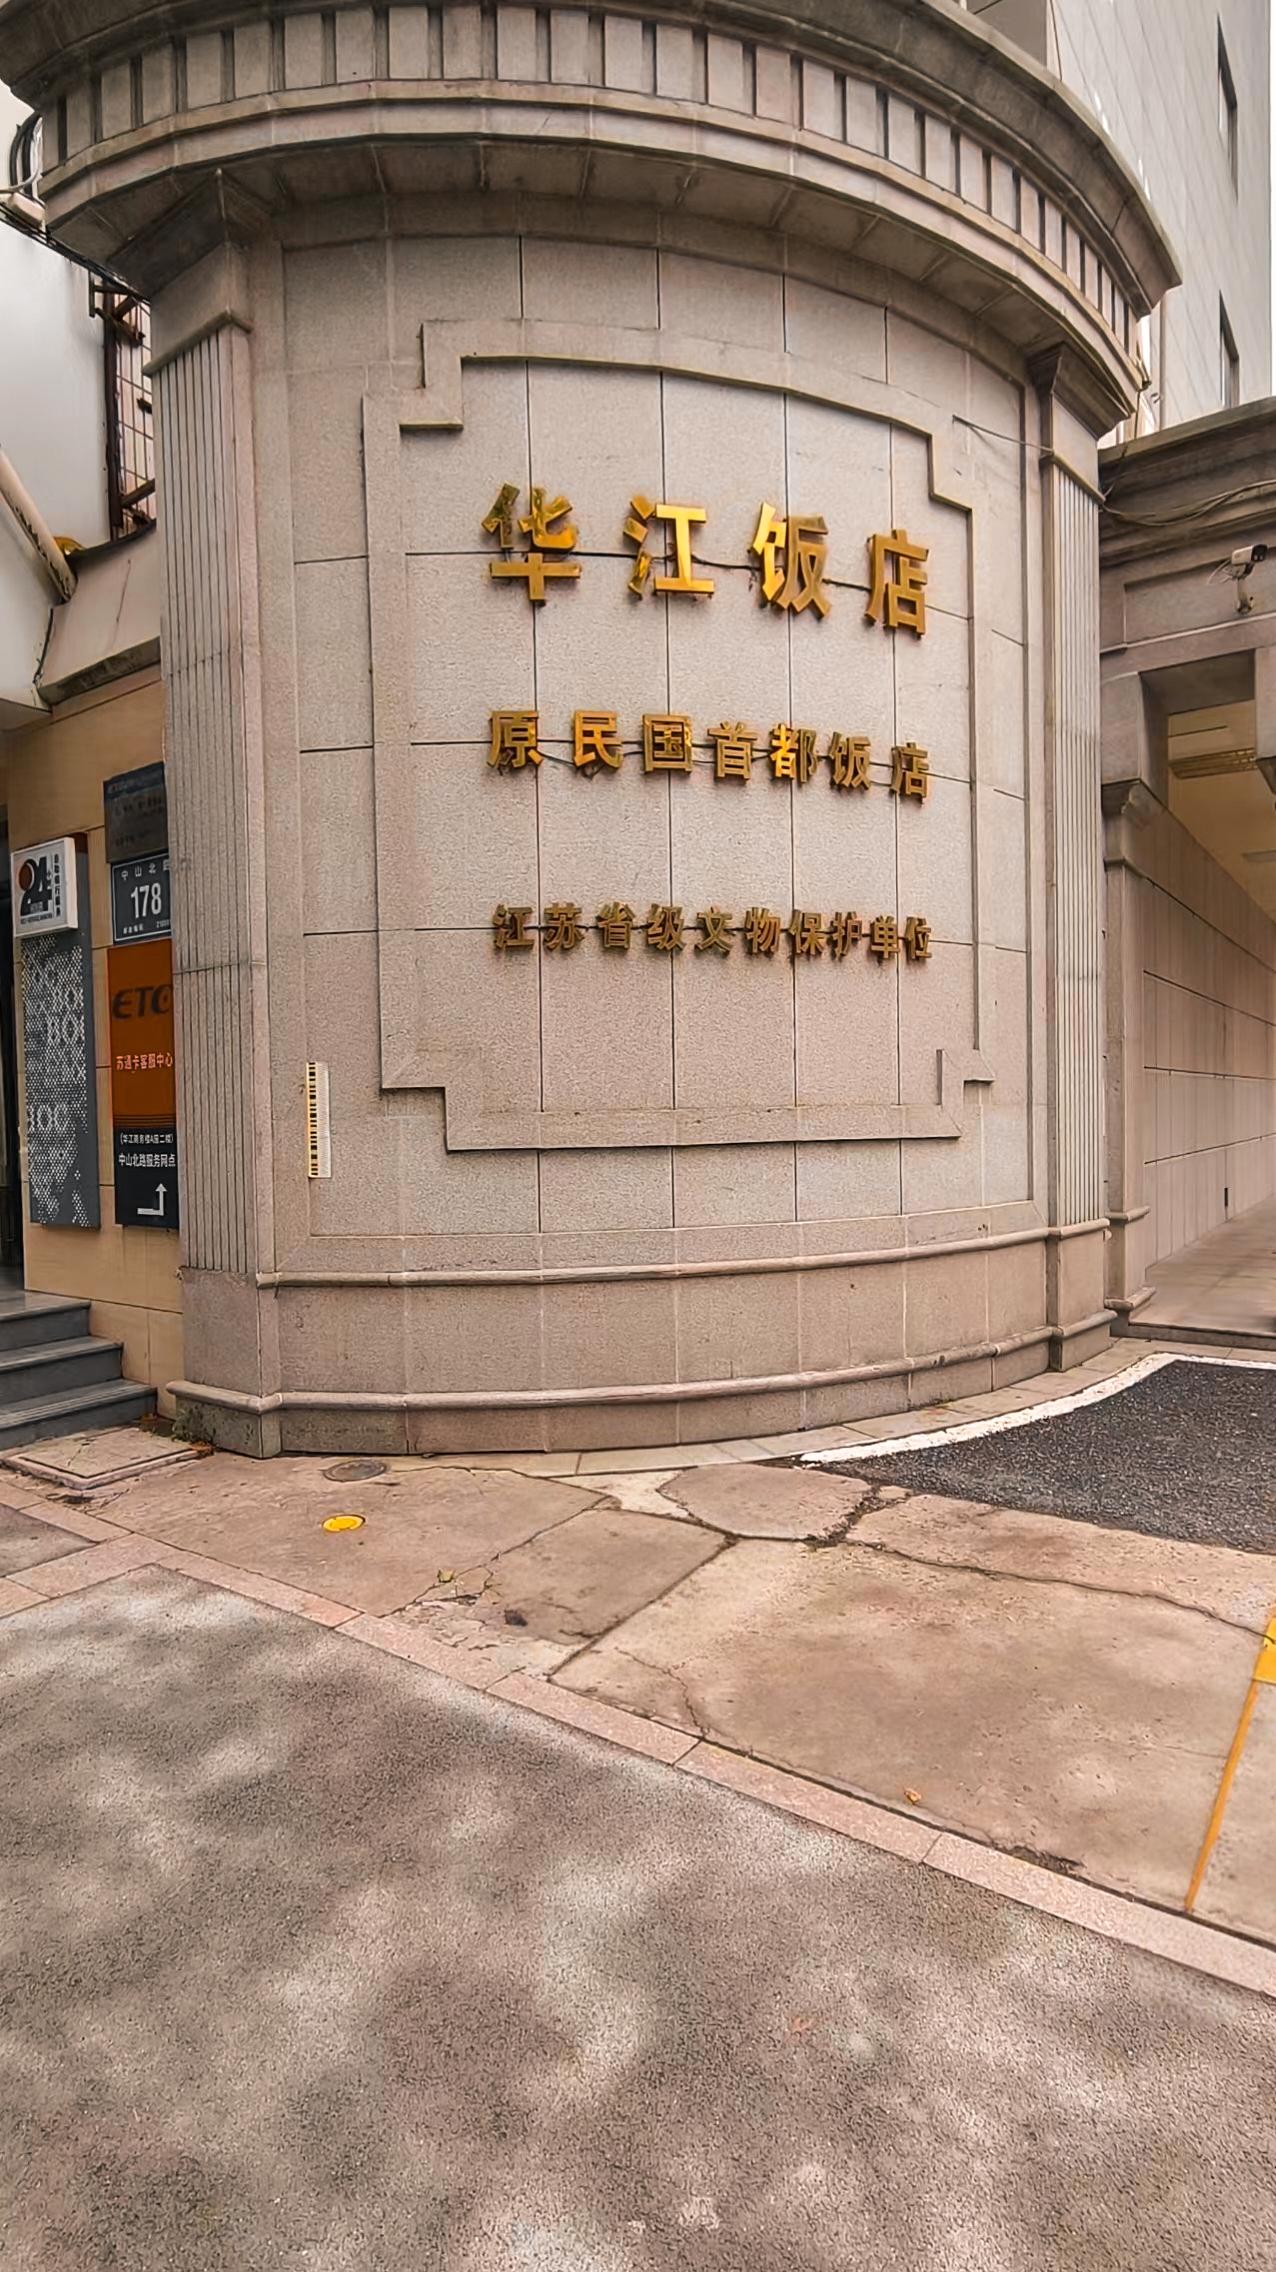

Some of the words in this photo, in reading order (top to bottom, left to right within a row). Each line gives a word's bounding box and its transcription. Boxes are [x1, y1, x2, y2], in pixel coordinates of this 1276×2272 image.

[481, 482, 930, 637] 华江饭店
[486, 709, 931, 801] 原民国首都饭店
[131, 883, 162, 919] 178
[492, 902, 933, 960] 江苏省级文物保护单位
[116, 1052, 173, 1070] 苏通卡客服中心
[119, 1152, 176, 1167] 中山北路服务网点
